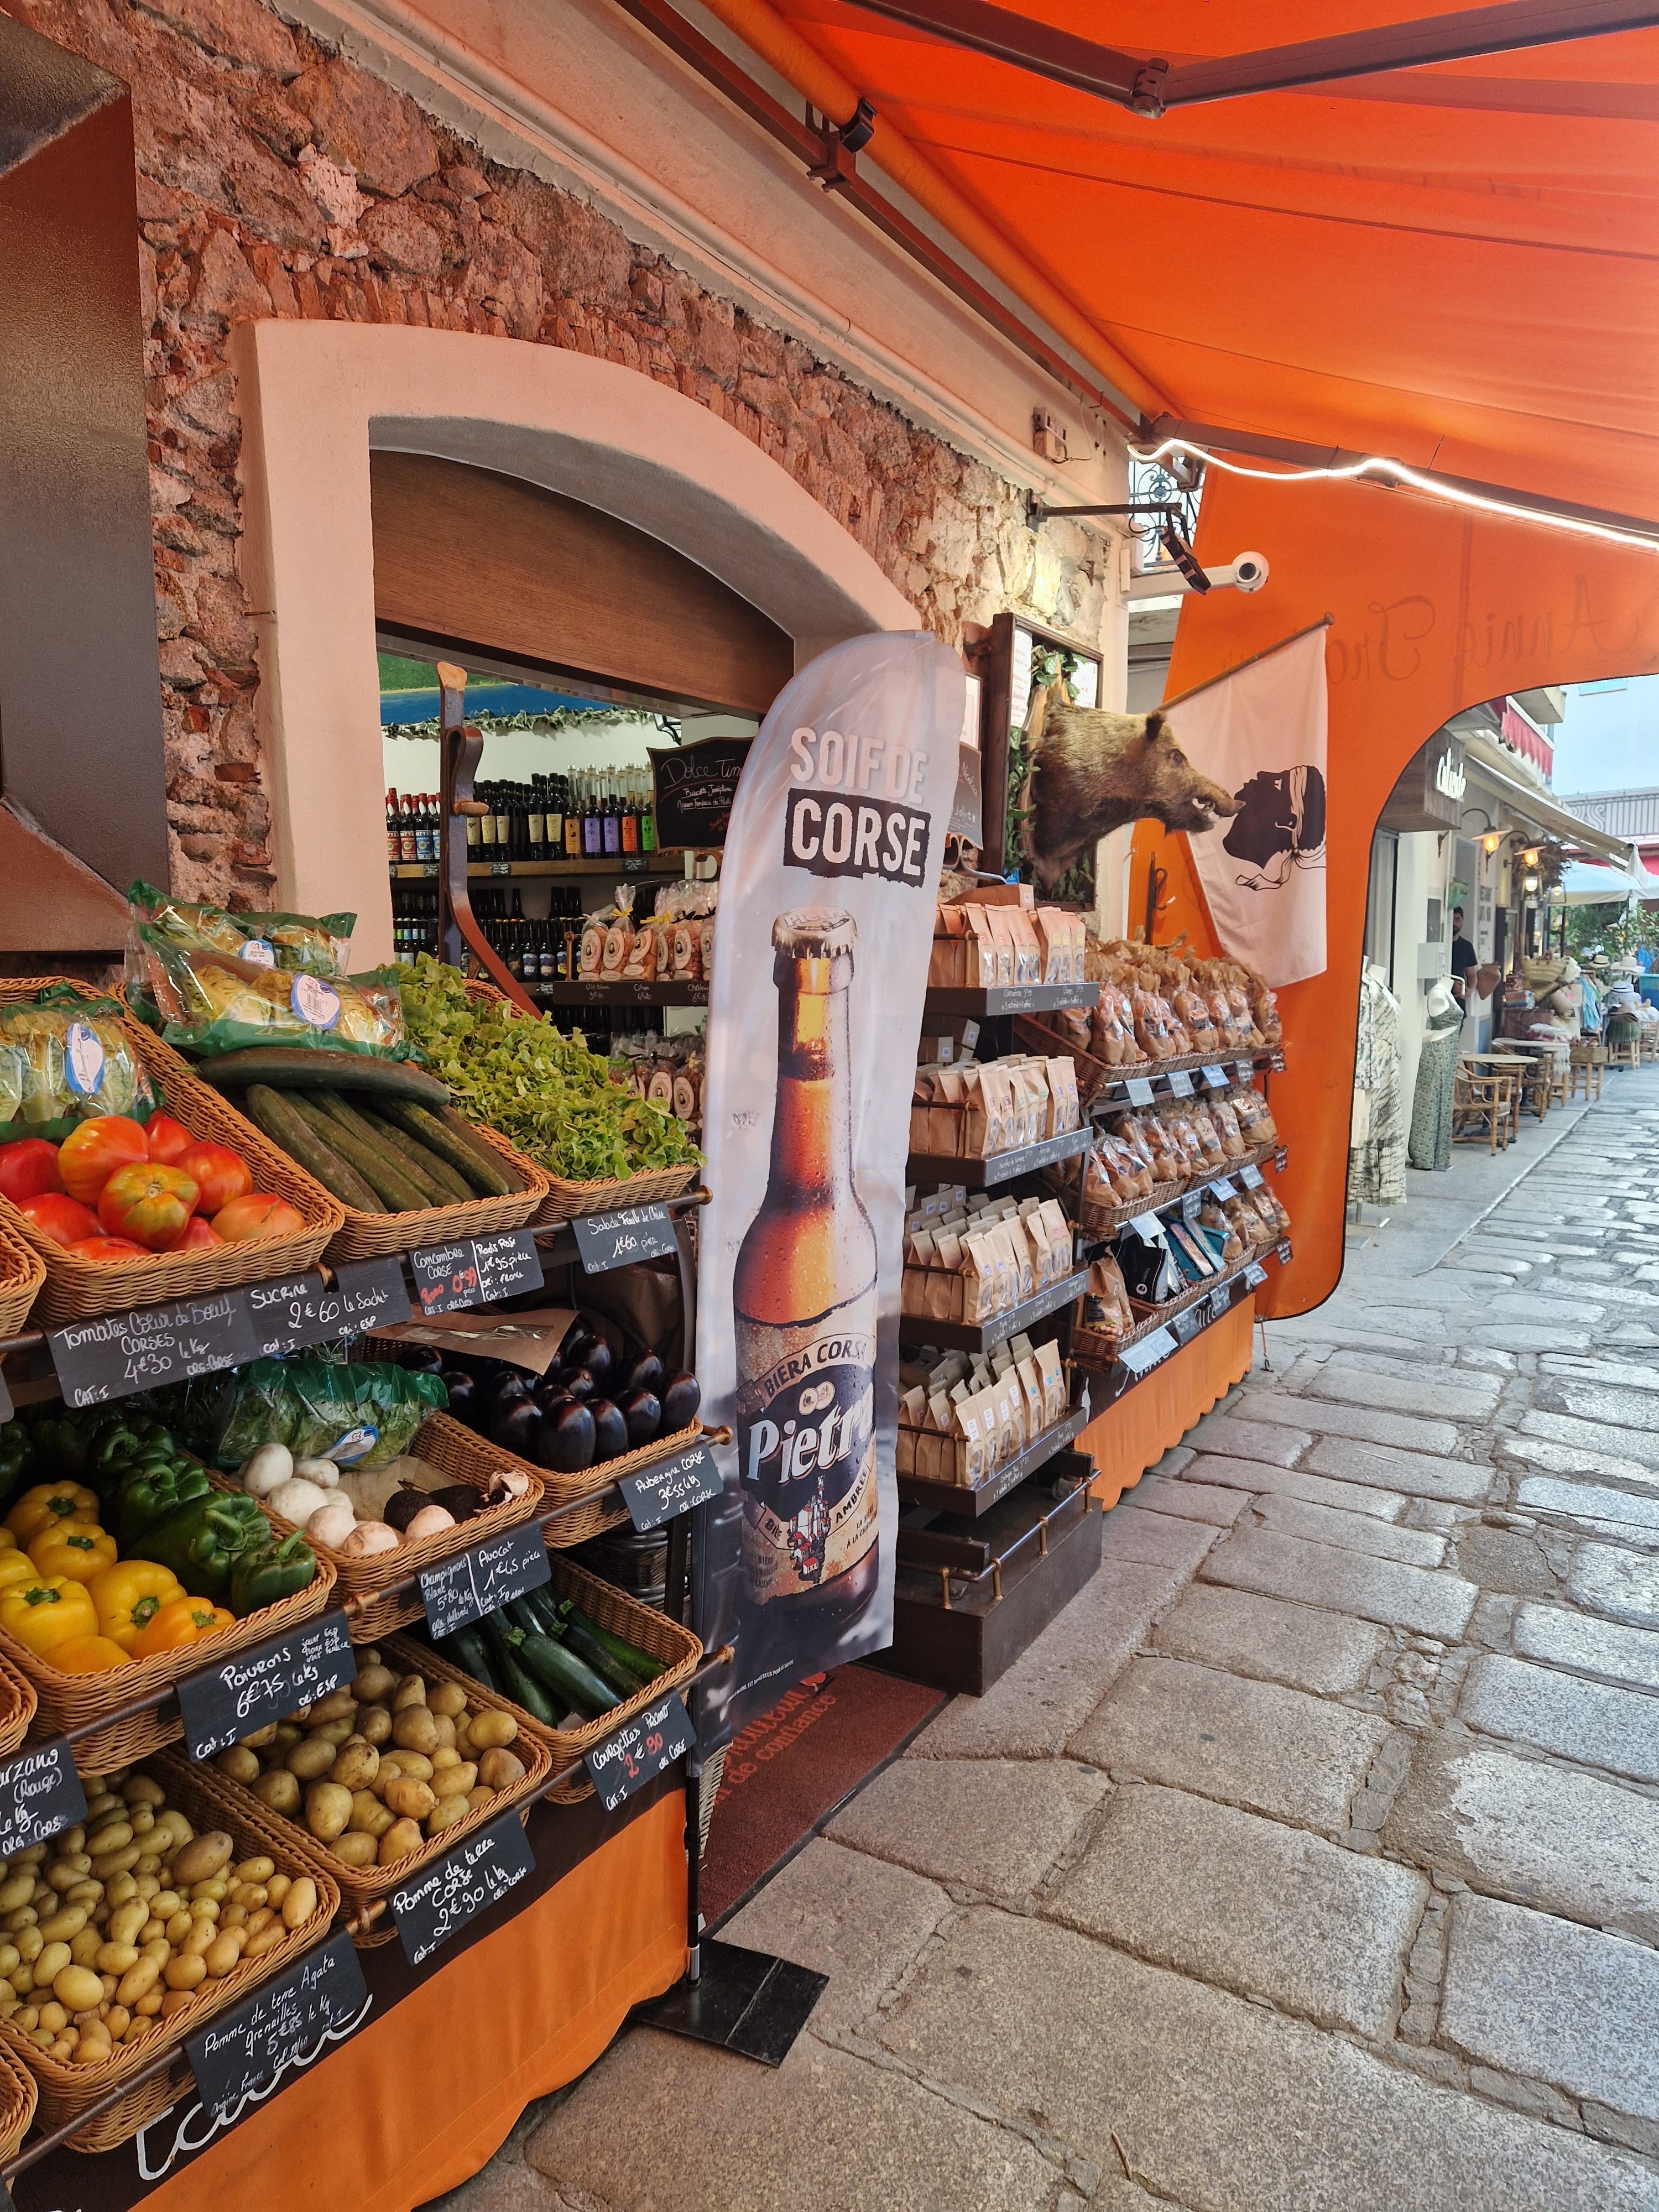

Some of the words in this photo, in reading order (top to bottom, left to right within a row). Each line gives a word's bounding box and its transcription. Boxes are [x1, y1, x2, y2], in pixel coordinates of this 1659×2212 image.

[660, 755, 718, 789] Dolce
[715, 758, 743, 778] Tim
[790, 726, 885, 790] SOIF
[886, 743, 929, 805] DE
[791, 796, 926, 876] CORSE
[587, 1217, 621, 1235] Salade
[54, 1318, 128, 1349] Tomates
[175, 1303, 190, 1326] de
[763, 1353, 812, 1398] BIERA
[478, 1541, 515, 1568] Avocat
[393, 1876, 442, 1914] Pomme
[445, 1860, 463, 1880] de
[205, 2023, 247, 2059] Pomme
[251, 2002, 267, 2026] de
[300, 1954, 336, 1990] Agata
